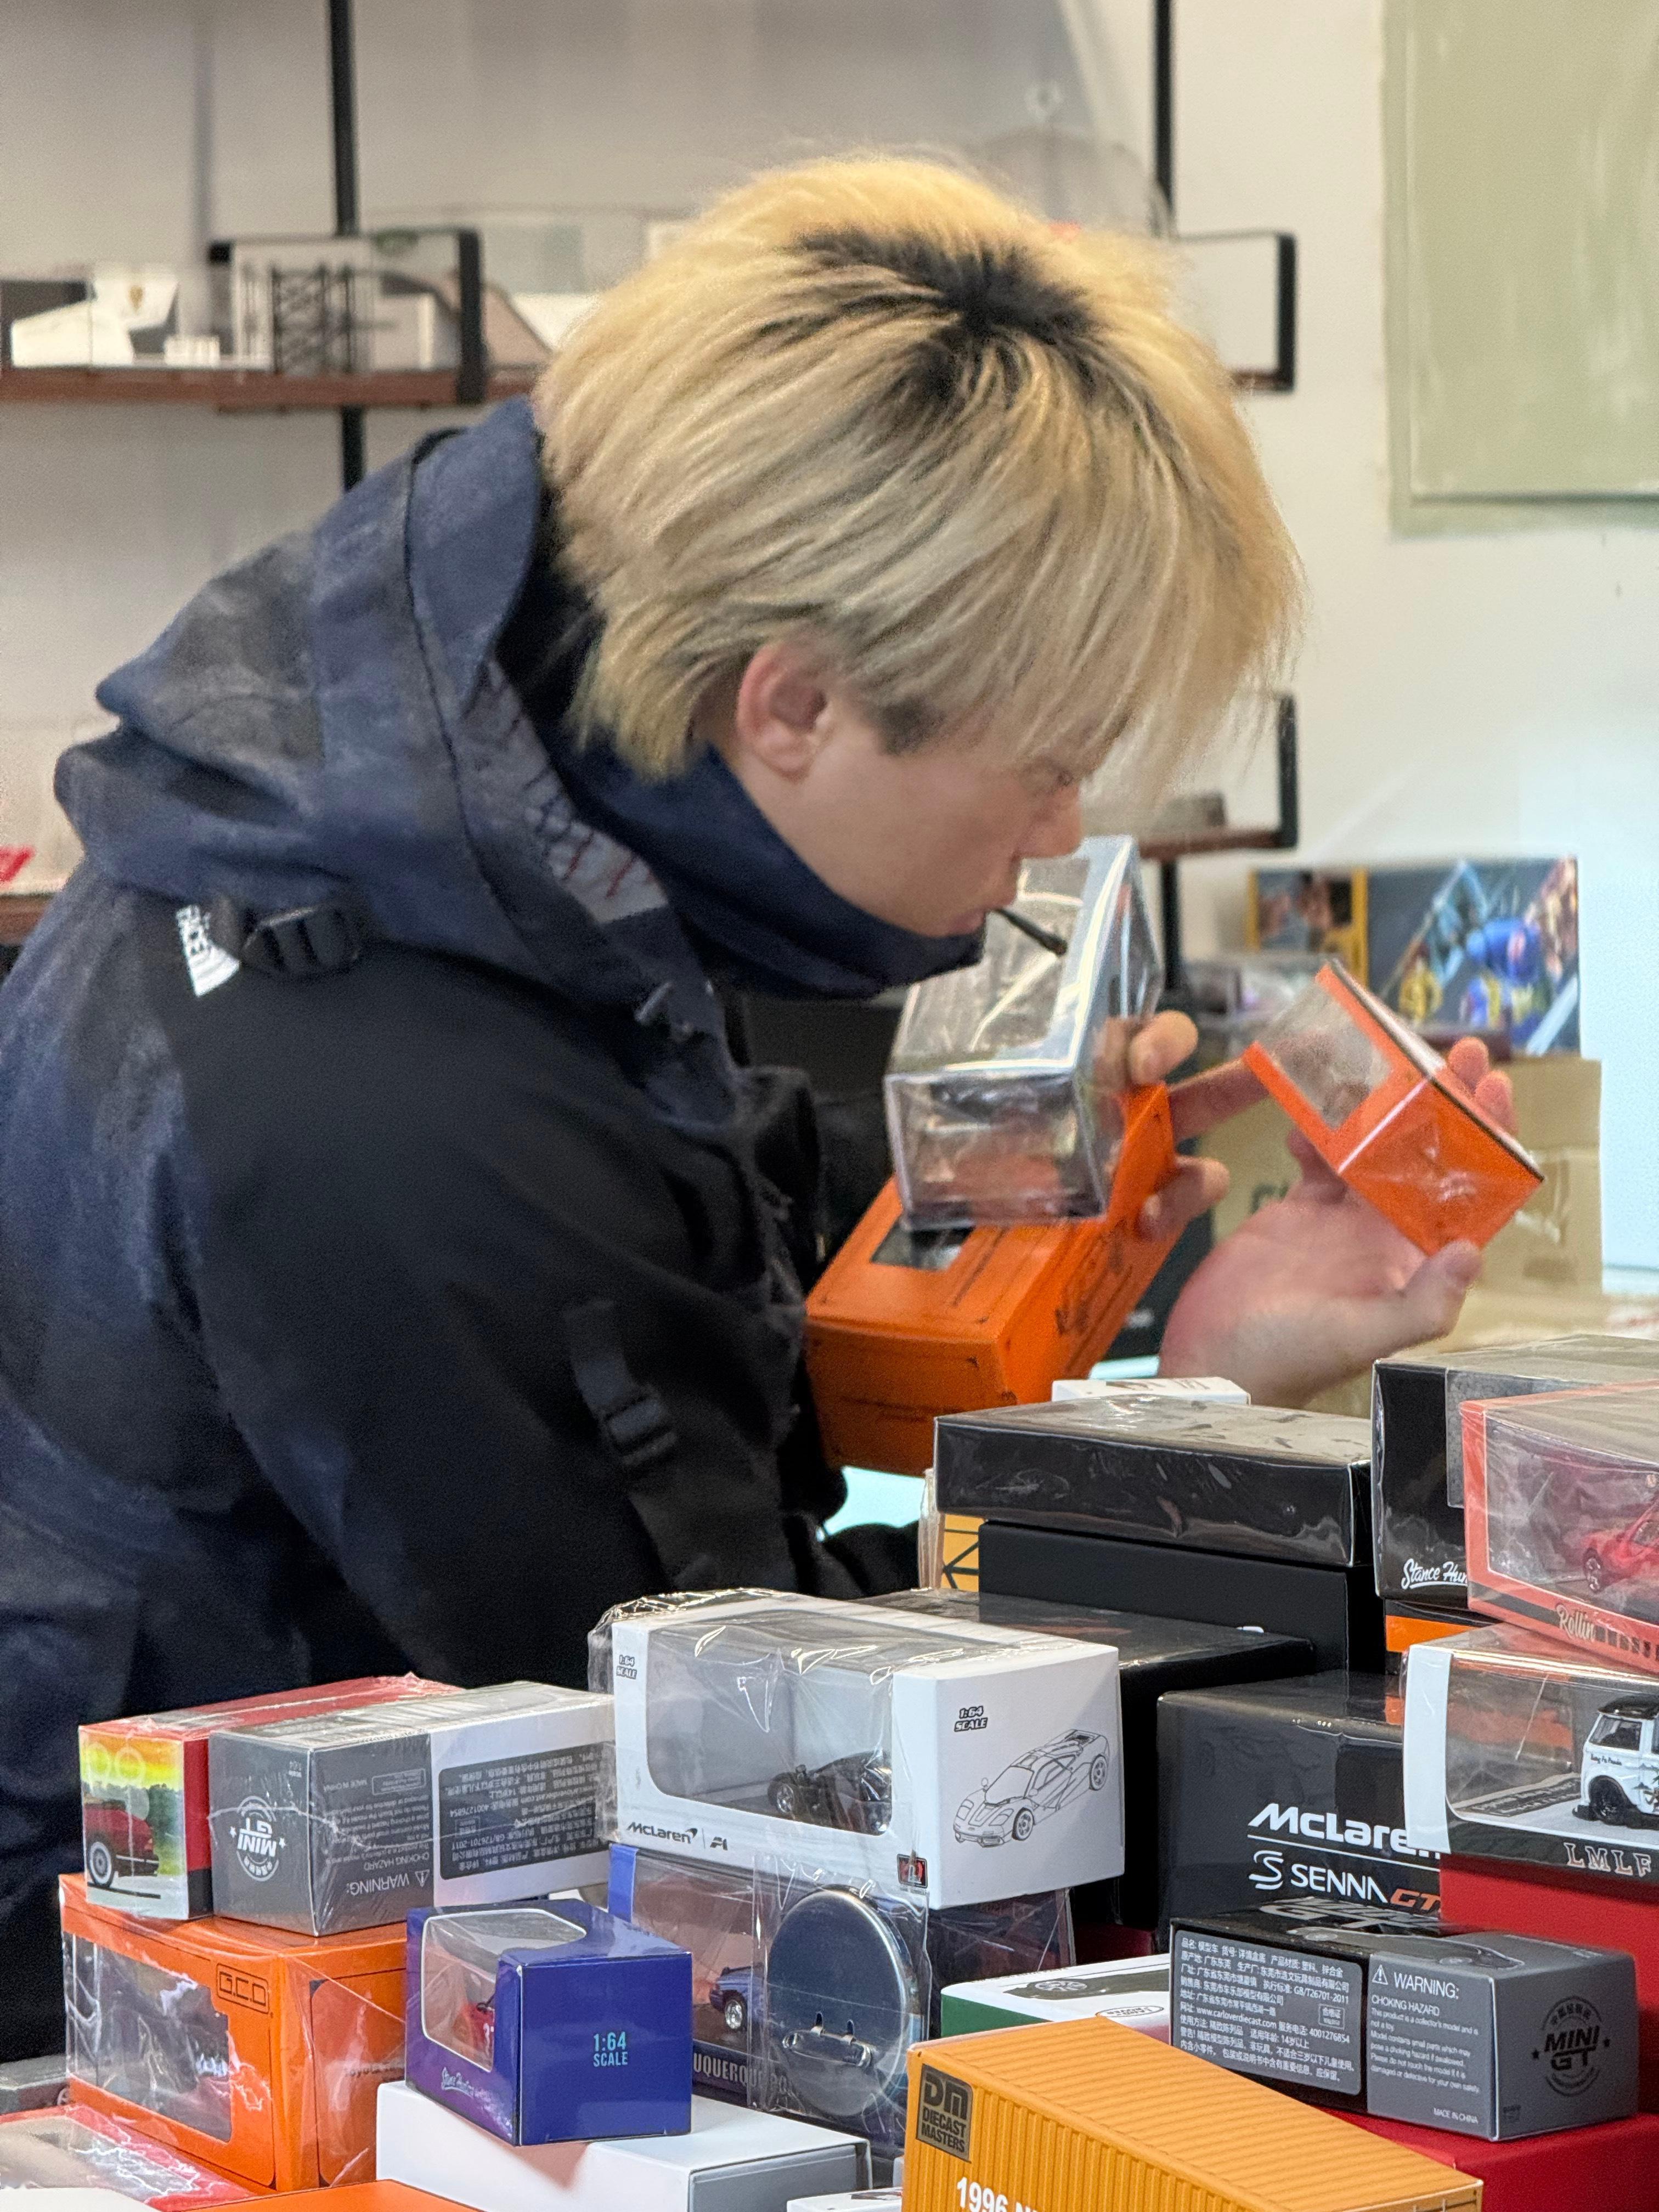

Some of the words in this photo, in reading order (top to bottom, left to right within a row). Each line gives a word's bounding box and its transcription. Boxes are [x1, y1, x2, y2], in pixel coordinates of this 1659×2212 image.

[1401, 1559, 1441, 1589] Stance
[954, 1717, 988, 1732] SCALE
[959, 1706, 984, 1719] 1:64
[239, 1818, 273, 1838] GT
[626, 1822, 692, 1844] McLaren
[237, 1833, 277, 1858] MINI
[346, 1872, 410, 1897] WARNING:
[1393, 1972, 1459, 2000] WARNING:
[1371, 1994, 1407, 2011] CHOKING
[1408, 2001, 1440, 2017] HAZARD
[593, 2032, 627, 2052] 1:64
[1309, 2027, 1350, 2044] 4001276854
[1544, 2025, 1600, 2052] MINI
[593, 2052, 628, 2068] SCALE
[1551, 2045, 1596, 2071] GT
[923, 2106, 967, 2138] DIECAST
[921, 2123, 965, 2154] MASTERS
[957, 2176, 1009, 2212] 1996
